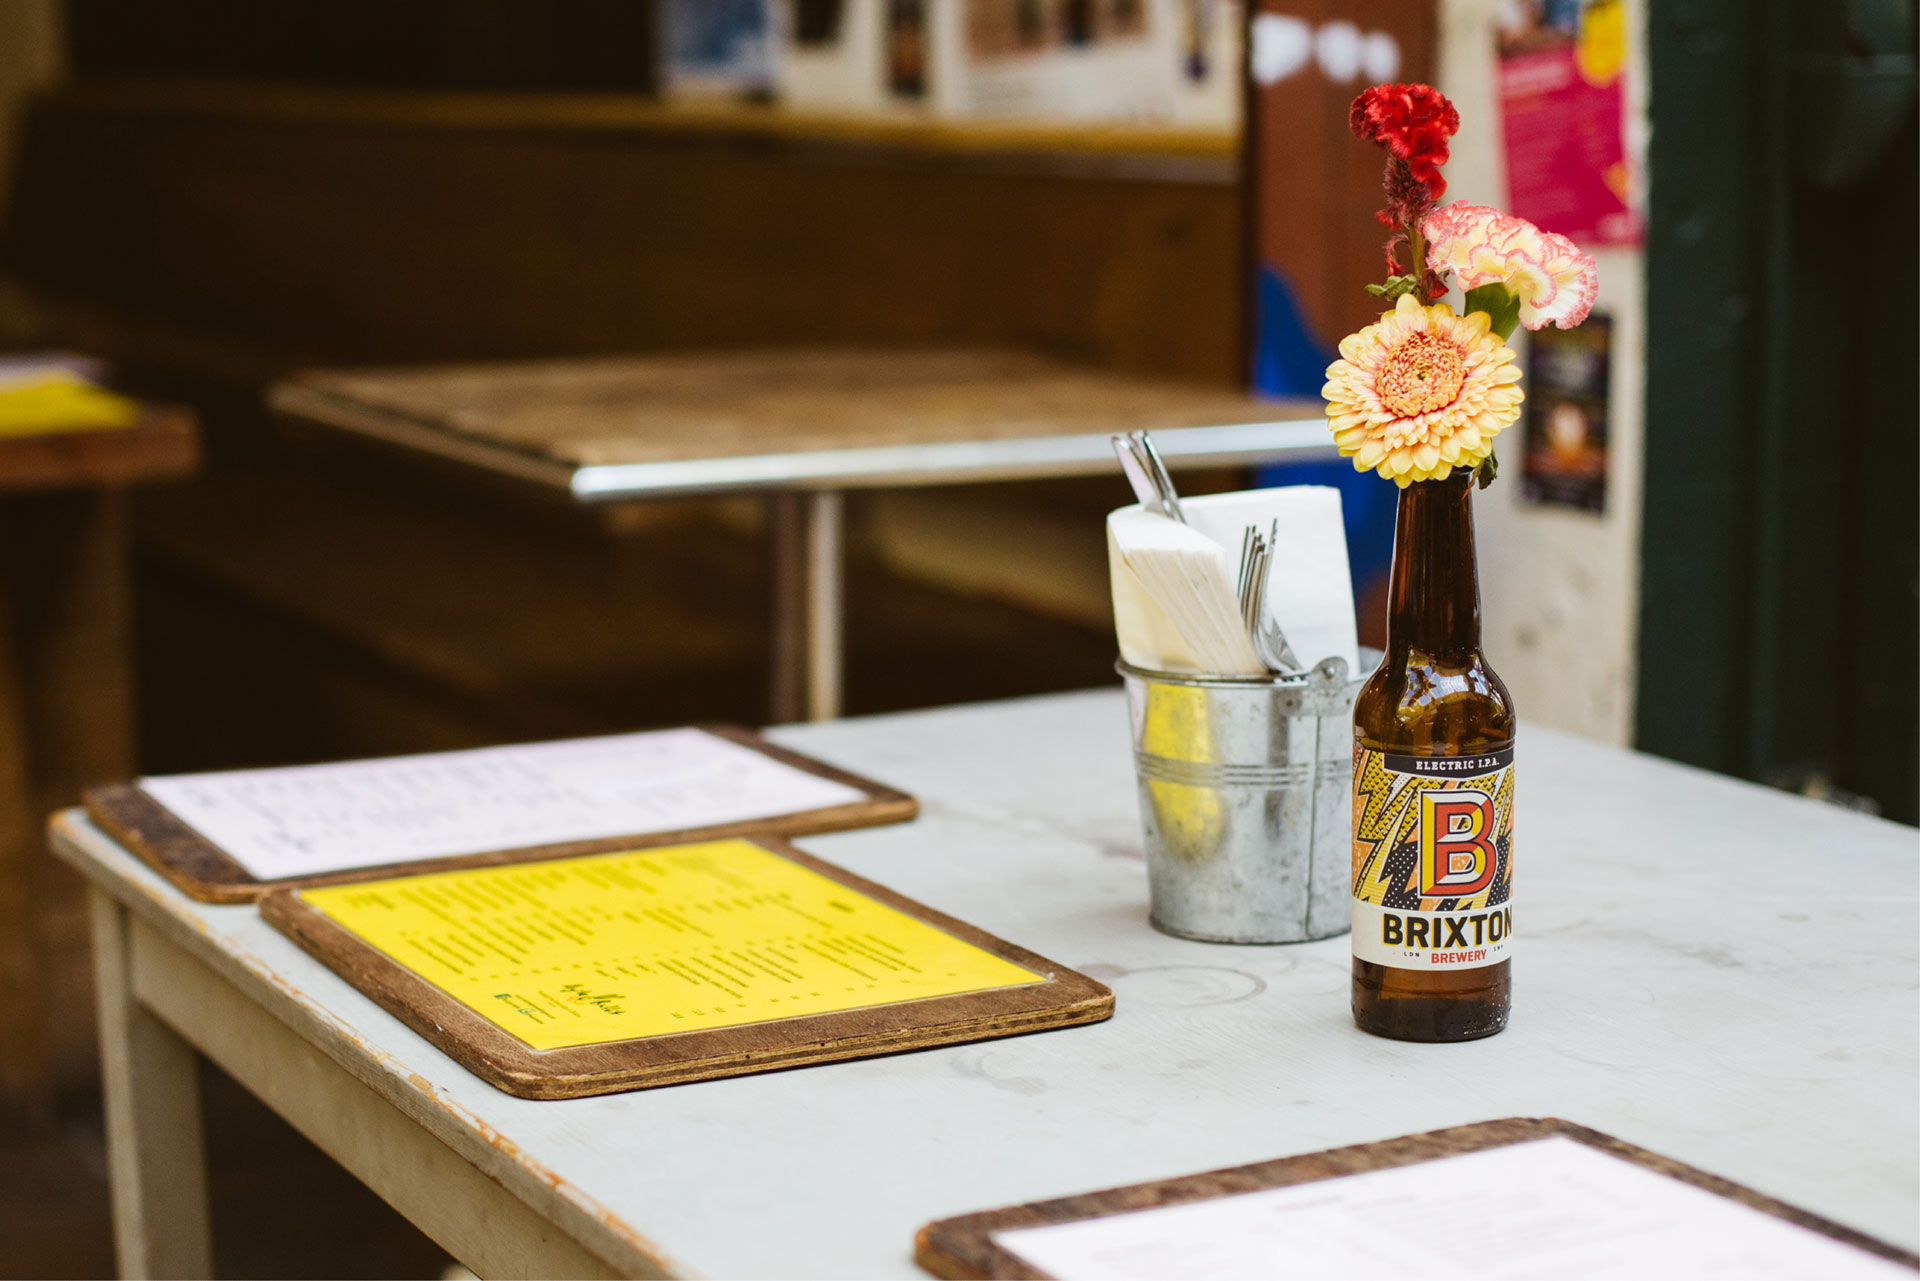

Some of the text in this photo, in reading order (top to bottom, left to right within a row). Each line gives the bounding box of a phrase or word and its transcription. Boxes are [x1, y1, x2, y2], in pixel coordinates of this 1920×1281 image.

[1416, 757, 1499, 771] ELECTRIC I.P.A.
[1418, 789, 1498, 898] B
[1382, 905, 1512, 949] BRIXTON
[1431, 949, 1487, 963] BREWERY
